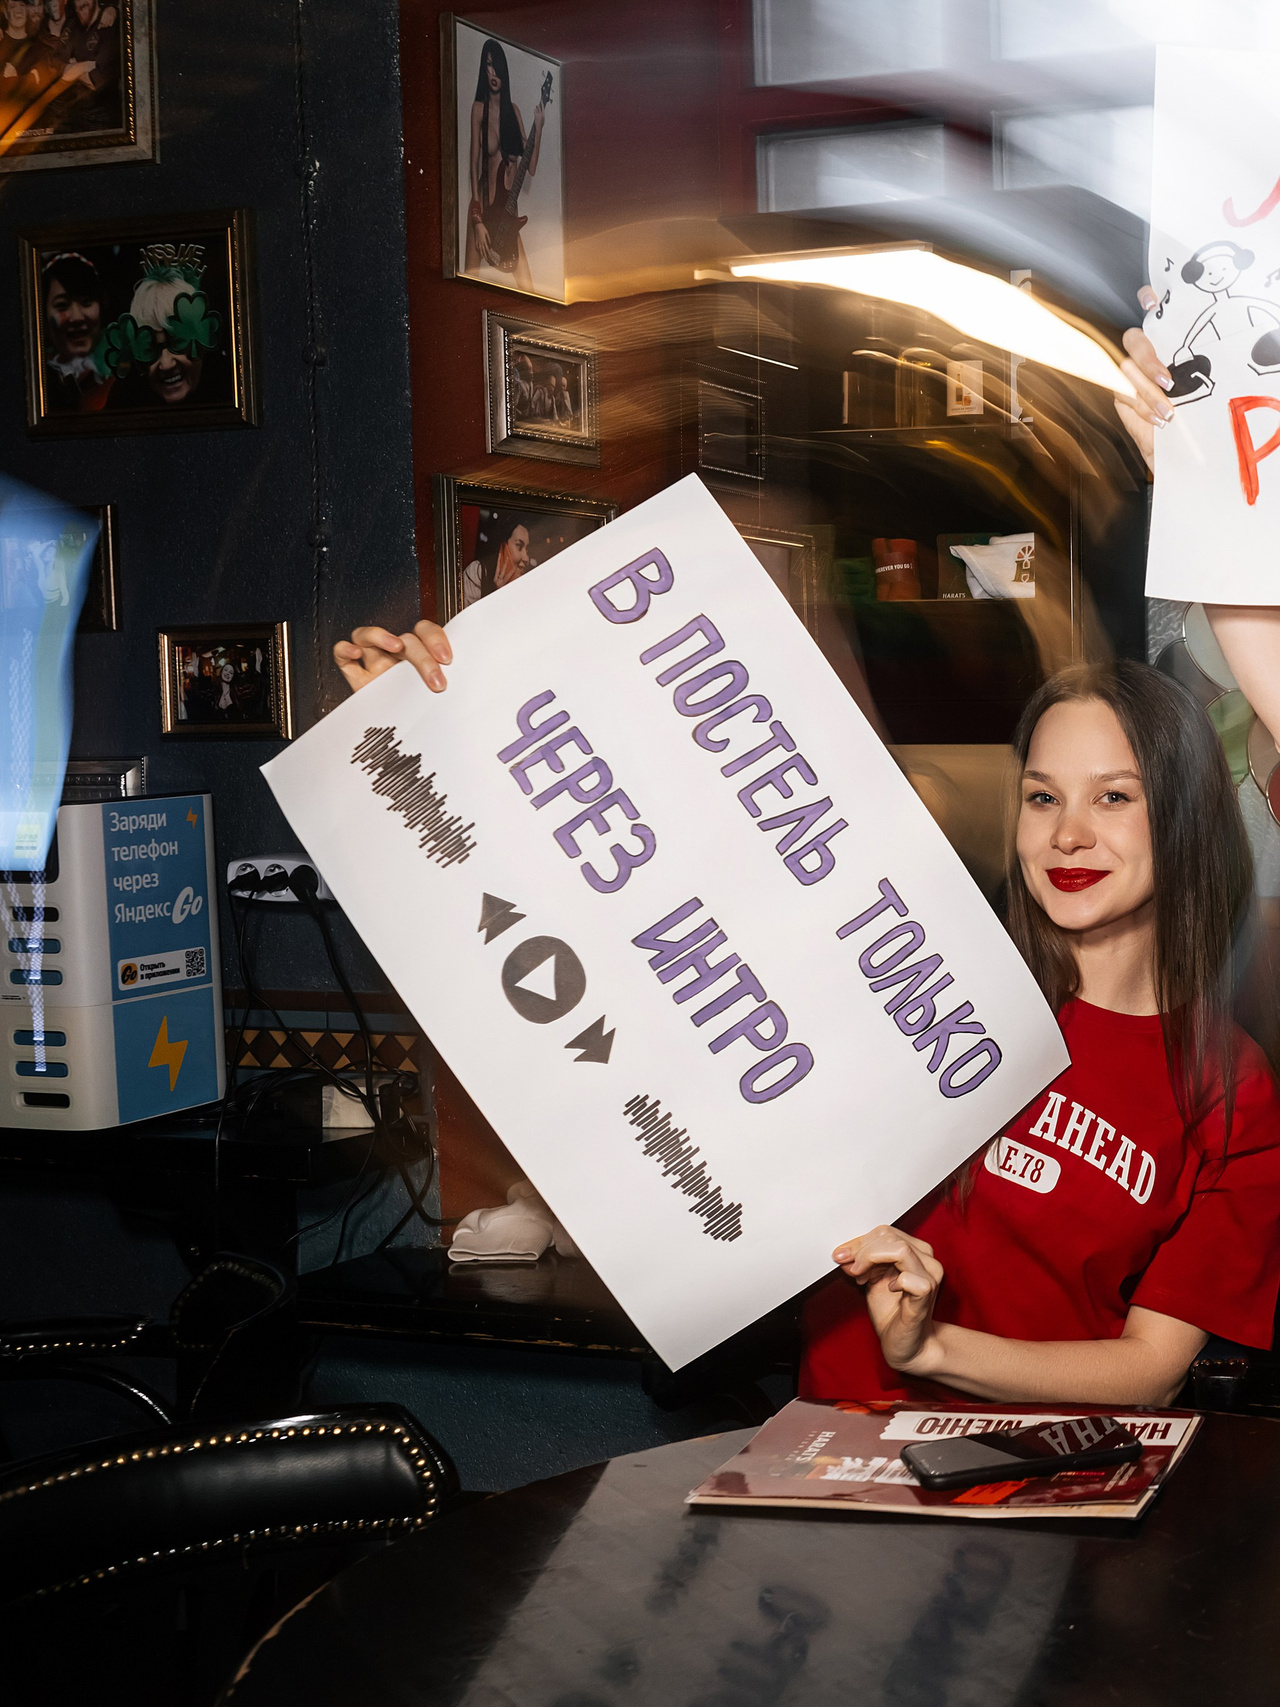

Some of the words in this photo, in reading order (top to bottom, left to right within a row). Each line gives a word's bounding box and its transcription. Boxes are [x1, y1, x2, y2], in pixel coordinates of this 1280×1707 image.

[109, 812, 168, 834] Заряди
[587, 547, 675, 624] В
[640, 613, 849, 886] ПОСТЕЛЬ
[836, 877, 1003, 1099] ТОЛЬКО
[111, 839, 178, 862] телефон
[113, 871, 160, 894] через
[496, 689, 657, 894] ЧЕРЕЗ
[631, 897, 814, 1104] ИНТРО
[114, 899, 172, 924] Яндекс
[172, 886, 203, 924] Go
[121, 965, 138, 984] Go
[1000, 1145, 1045, 1184] E.78
[1028, 1091, 1157, 1205] AHEAD
